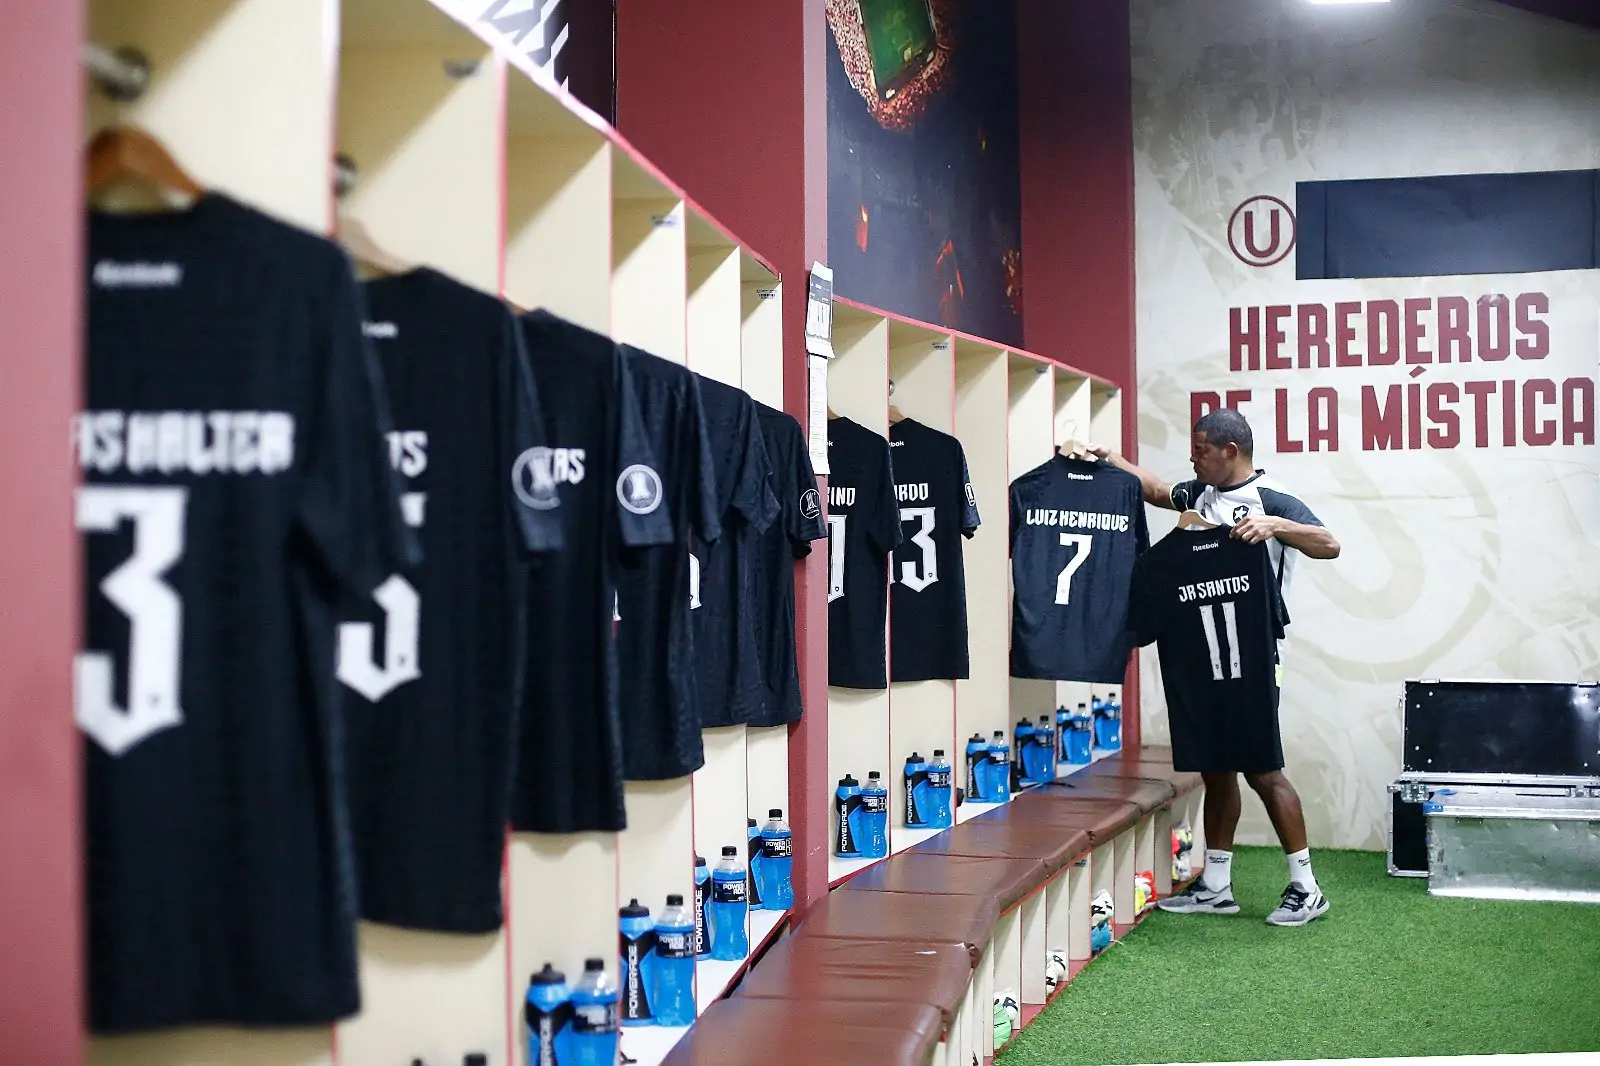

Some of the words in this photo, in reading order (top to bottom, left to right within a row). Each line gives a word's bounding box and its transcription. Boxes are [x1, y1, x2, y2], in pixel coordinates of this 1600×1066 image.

[1244, 208, 1280, 258] U
[1229, 292, 1549, 371] HEREDEROS
[1275, 387, 1339, 452] LA
[1361, 365, 1595, 451] MÍSTICA
[889, 440, 905, 448] bok
[1067, 472, 1094, 481] Reebok
[899, 506, 939, 592] 3
[1026, 508, 1058, 526] LUIZ
[1059, 510, 1129, 532] HENRIQUE
[1192, 541, 1219, 552] Reebok
[1054, 532, 1094, 605] 7
[1178, 584, 1197, 602] JR
[1197, 575, 1250, 599] SANTOS
[1199, 601, 1243, 681] 11
[695, 888, 703, 953] POWERADE
[628, 944, 638, 1019] POWERADE
